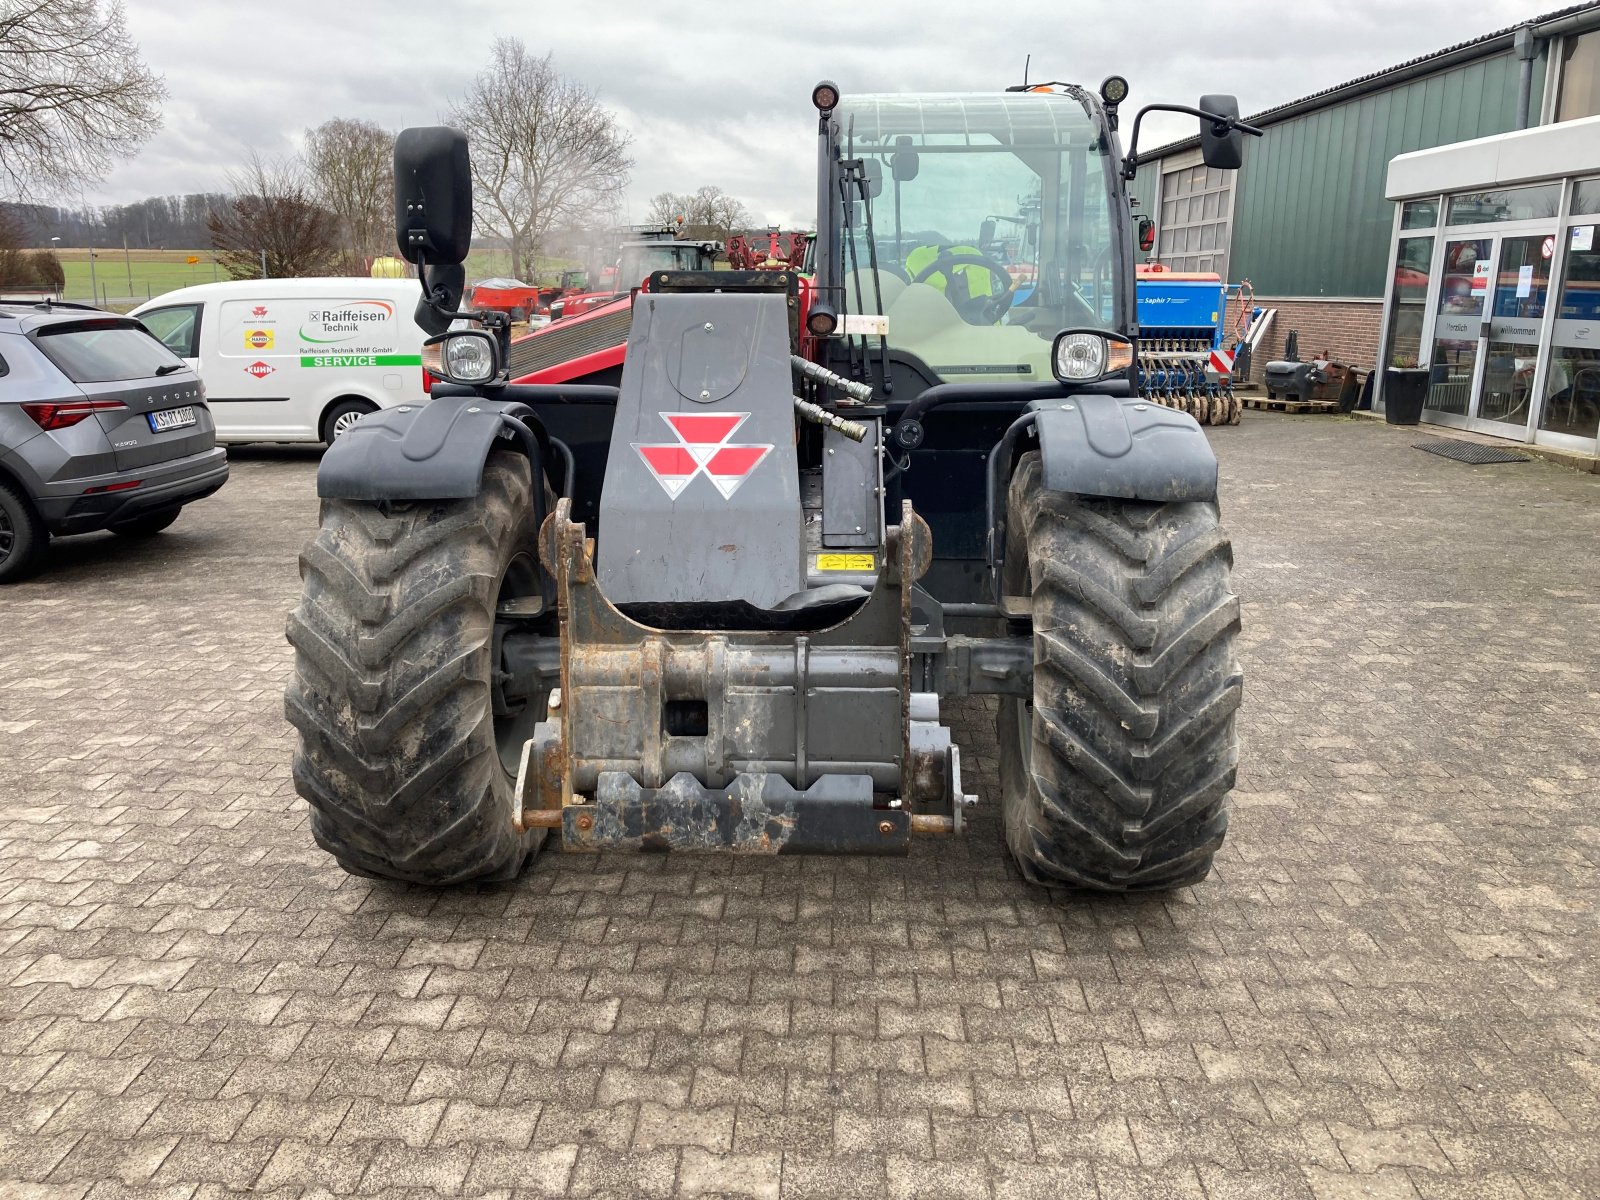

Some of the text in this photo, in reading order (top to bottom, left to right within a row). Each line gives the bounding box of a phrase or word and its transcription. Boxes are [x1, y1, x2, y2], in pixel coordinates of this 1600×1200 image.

[322, 310, 385, 322] Raiffeisen
[322, 323, 358, 332] Technik
[1500, 326, 1536, 336] willkommen
[314, 356, 377, 366] SERVICE
